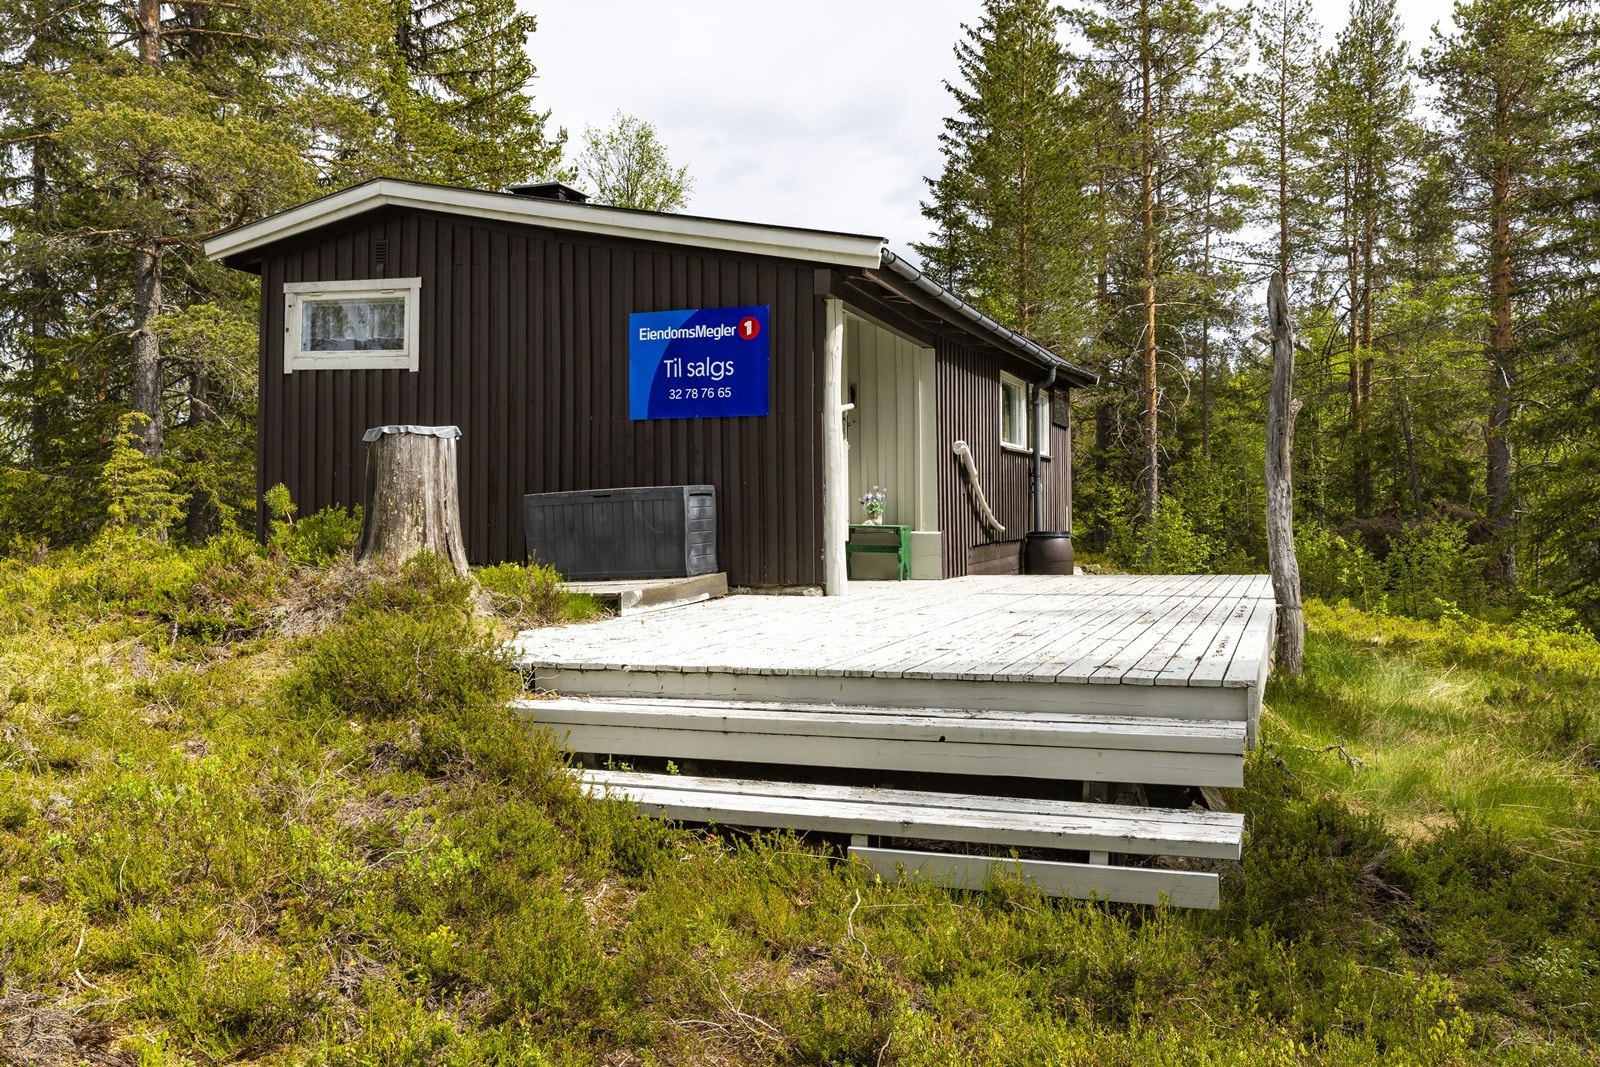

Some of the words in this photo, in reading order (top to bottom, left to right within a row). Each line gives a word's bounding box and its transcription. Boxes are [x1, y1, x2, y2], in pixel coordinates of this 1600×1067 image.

[639, 324, 737, 341] EiendomsMegler
[744, 320, 753, 336] 1
[663, 357, 683, 378] Til
[686, 356, 735, 381] salgs
[669, 388, 682, 400] 32
[685, 388, 699, 399] 78
[701, 387, 715, 399] 76
[717, 387, 732, 398] 65
